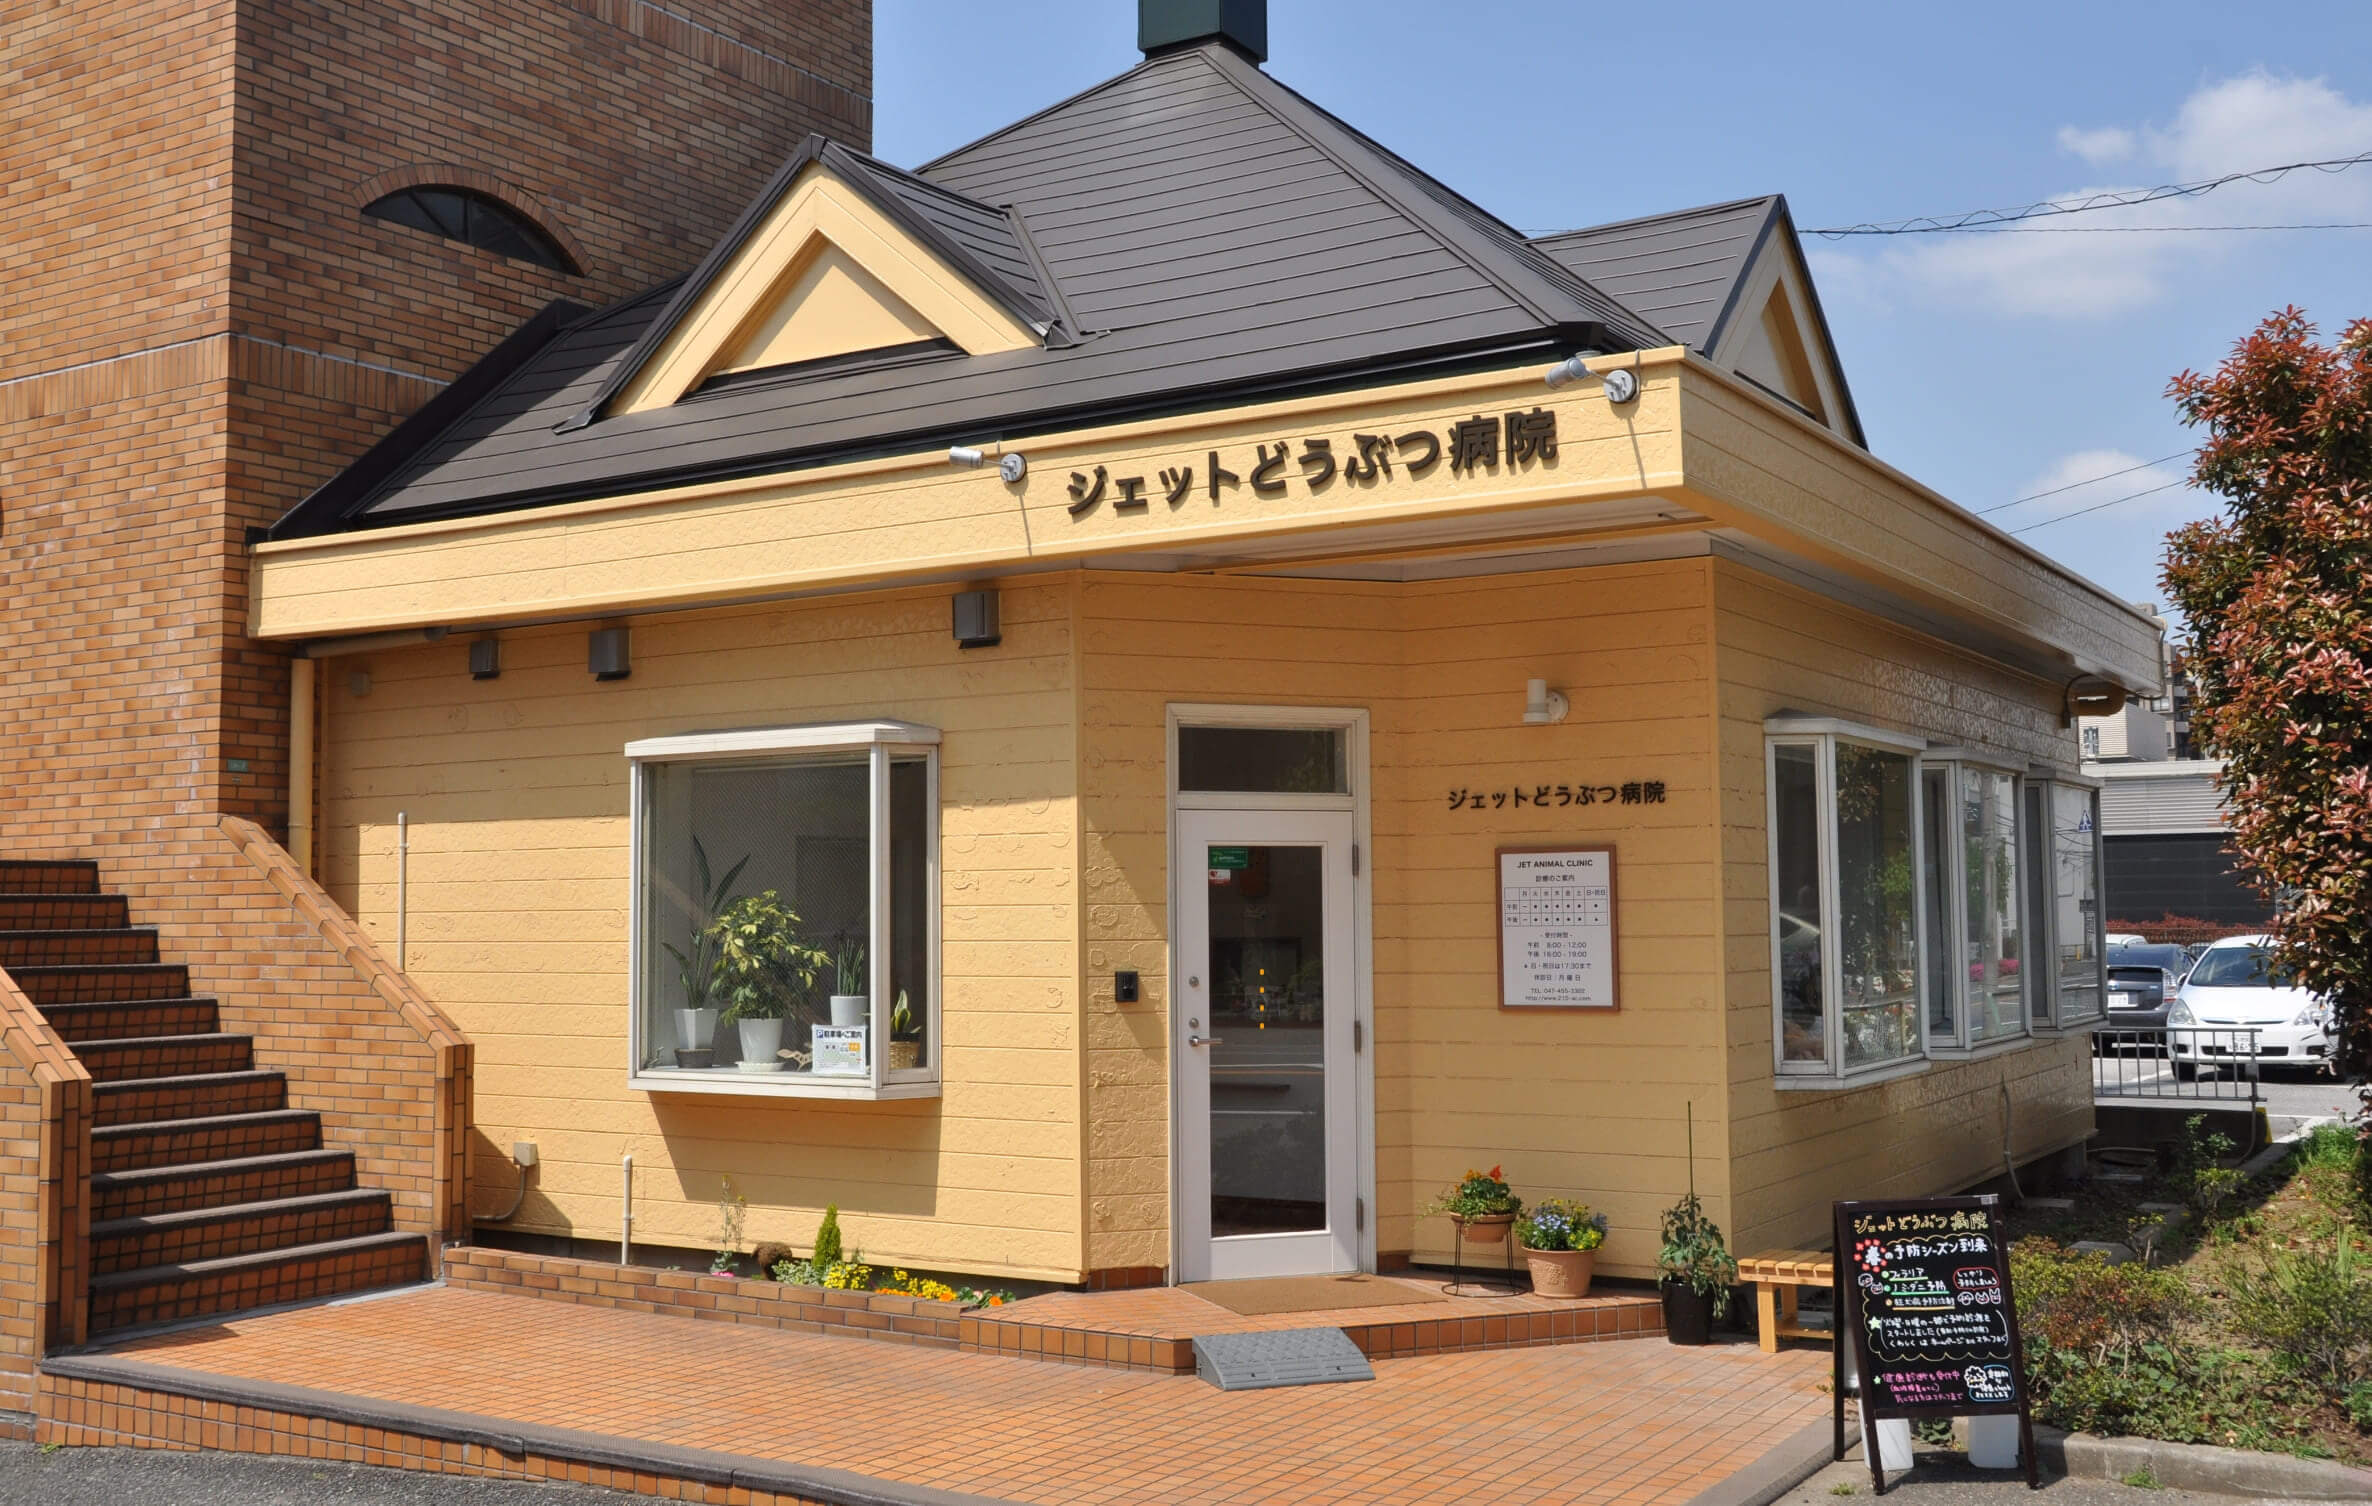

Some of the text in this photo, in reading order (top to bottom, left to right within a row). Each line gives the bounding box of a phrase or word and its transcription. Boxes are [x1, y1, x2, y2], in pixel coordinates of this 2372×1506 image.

[1067, 407, 1557, 516] ジェットどうぶつ病院
[1448, 781, 1665, 810] ジェットどうぶつ病院
[1517, 859, 1593, 869] JET ANIMAL CLINIC
[1865, 1237, 1988, 1266] 春の予防シーズン到来
[1889, 1267, 1925, 1278] フィラリア
